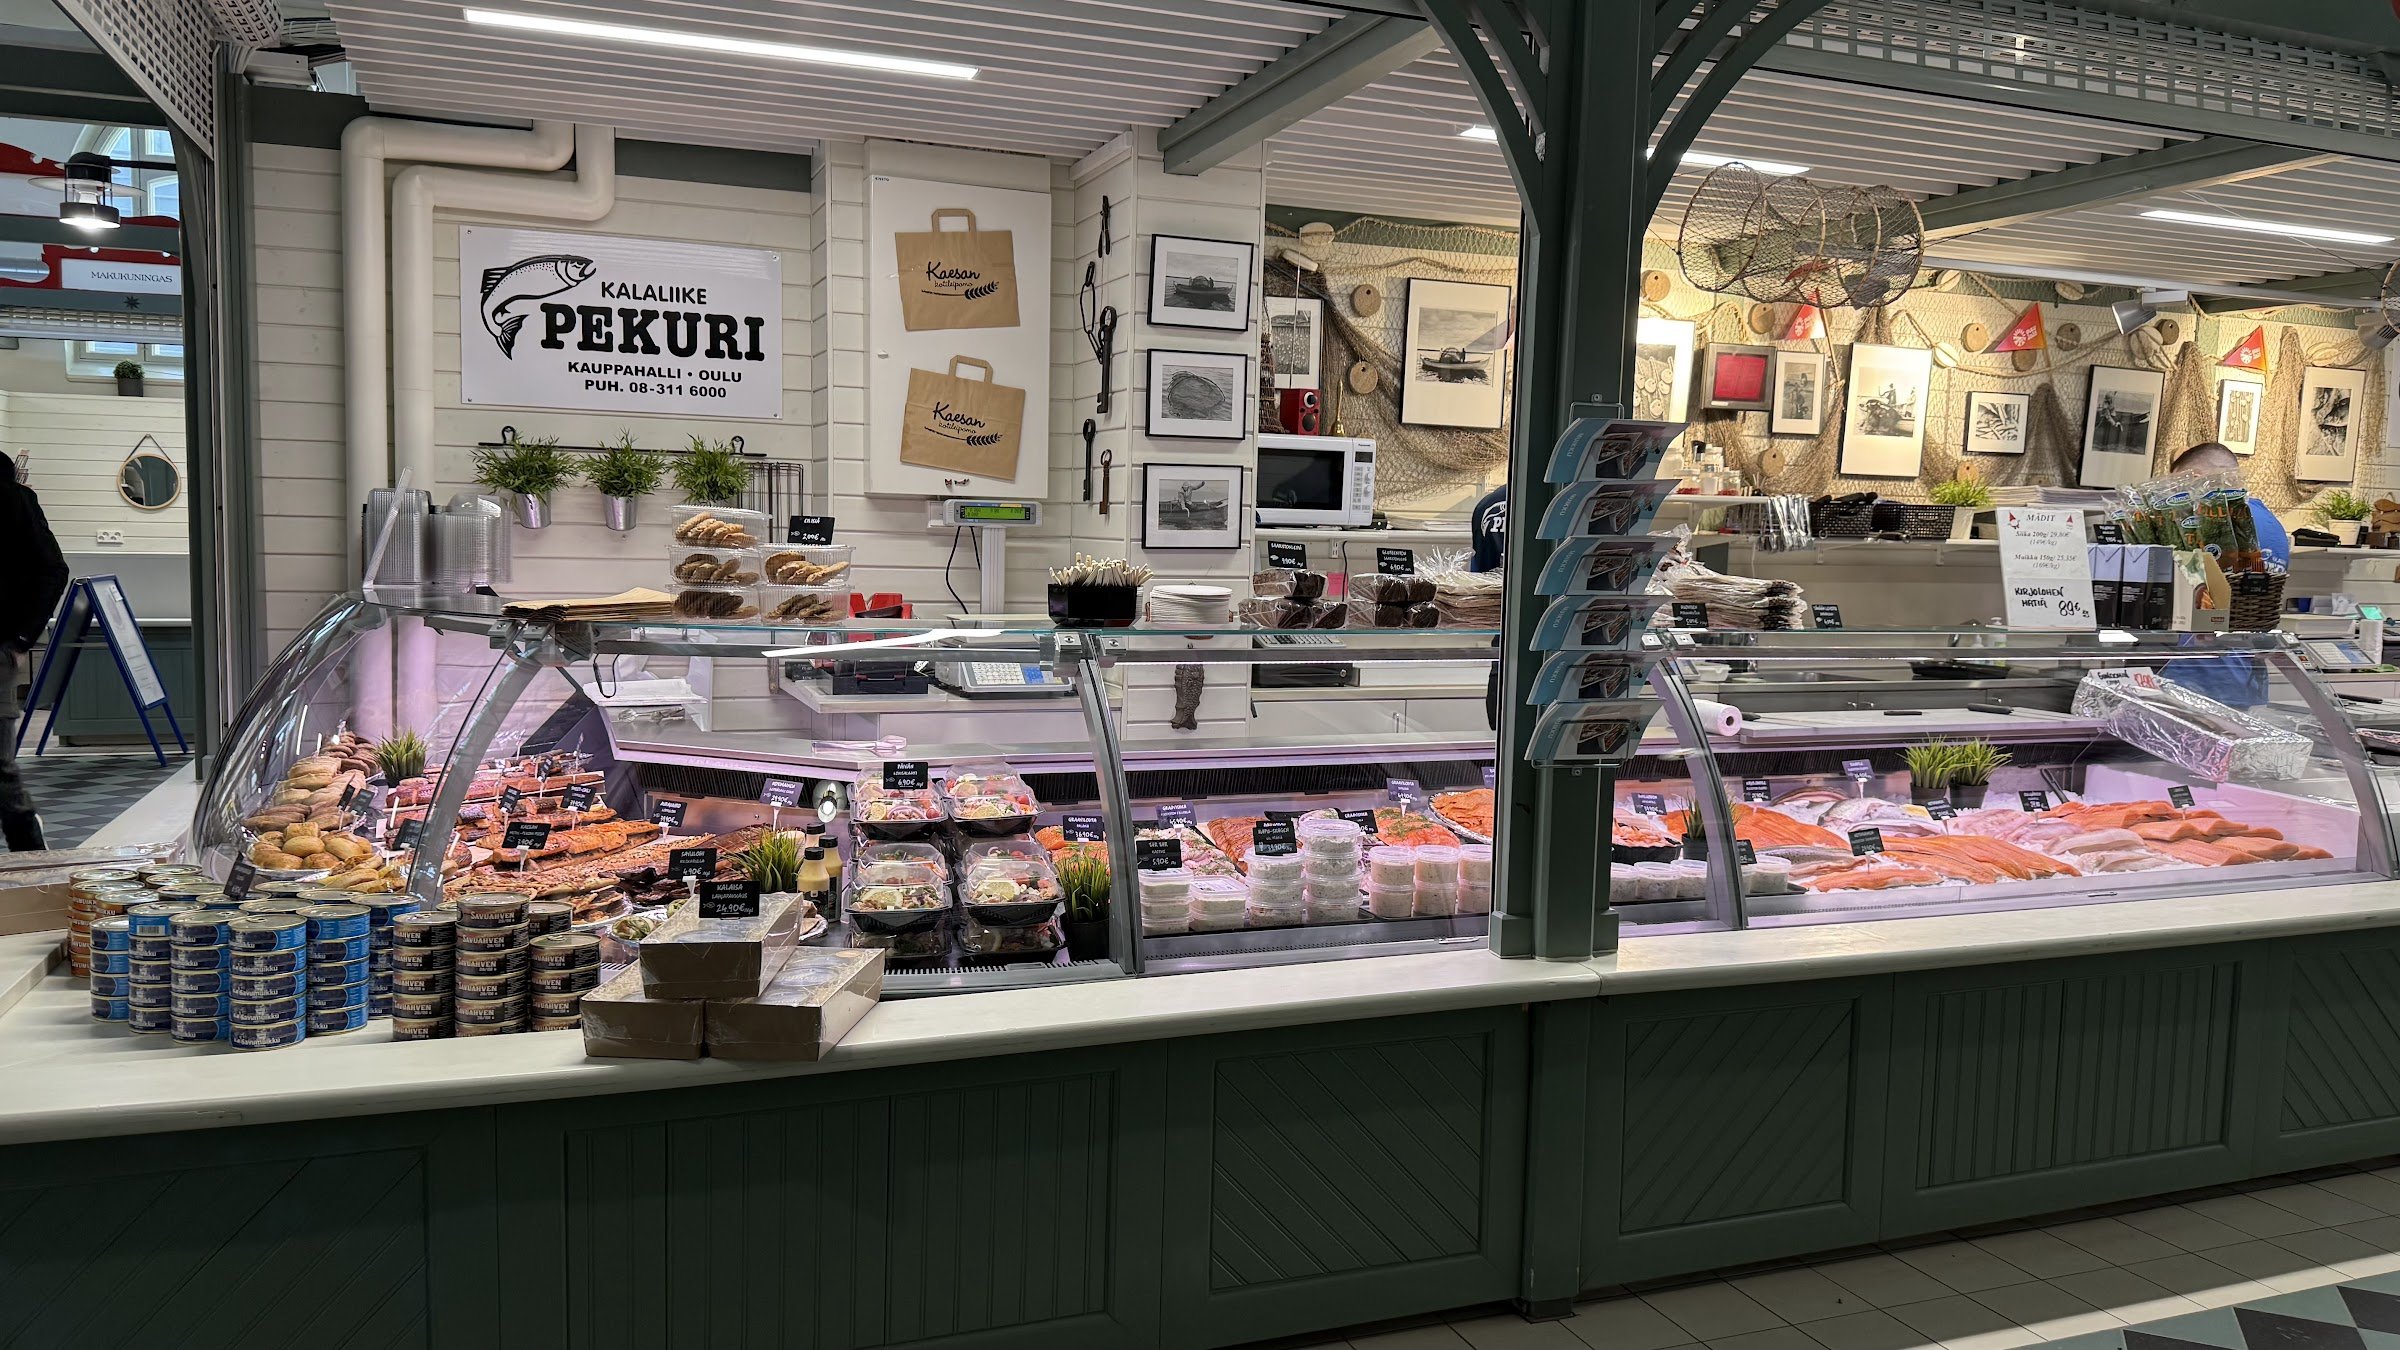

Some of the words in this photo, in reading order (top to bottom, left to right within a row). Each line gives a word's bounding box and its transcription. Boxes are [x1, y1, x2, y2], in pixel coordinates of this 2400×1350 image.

[91, 271, 173, 283] MAKUKUNINGAS
[926, 261, 980, 281] Kaesan
[601, 281, 707, 305] KALALIIKE
[540, 302, 765, 362] PEKURI
[567, 361, 681, 379] KAUPPAHALLI
[698, 369, 742, 383] OULU
[584, 379, 624, 393] PUH.
[629, 381, 684, 396] 08-311
[689, 385, 727, 398] 6000
[932, 401, 986, 428] Kaesan
[2026, 513, 2056, 522] MÄDIT
[716, 902, 745, 913] 24.90€
